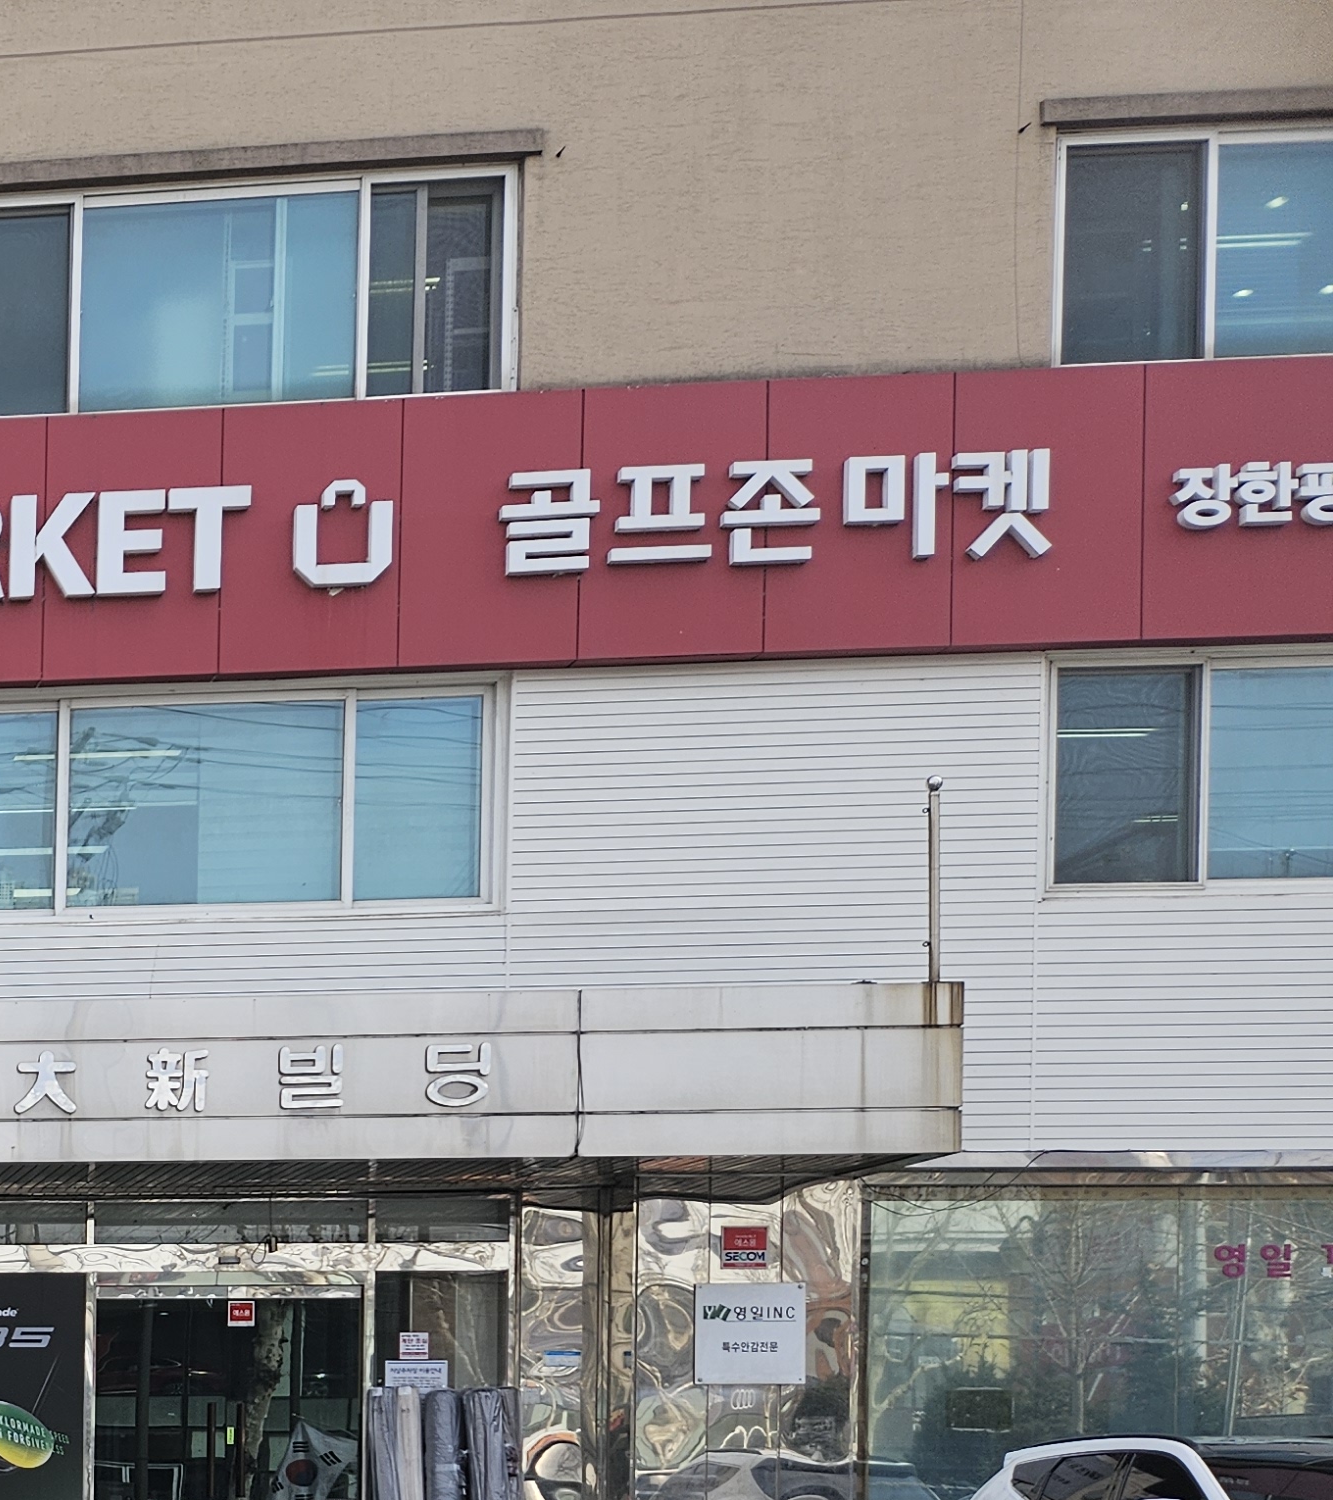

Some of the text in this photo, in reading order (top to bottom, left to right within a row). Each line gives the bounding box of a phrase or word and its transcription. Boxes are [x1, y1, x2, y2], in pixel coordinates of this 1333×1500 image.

[499, 448, 1052, 577] 골프존마켓
[725, 1251, 765, 1261] SECOM
[721, 1341, 779, 1353] 특수안감전문
